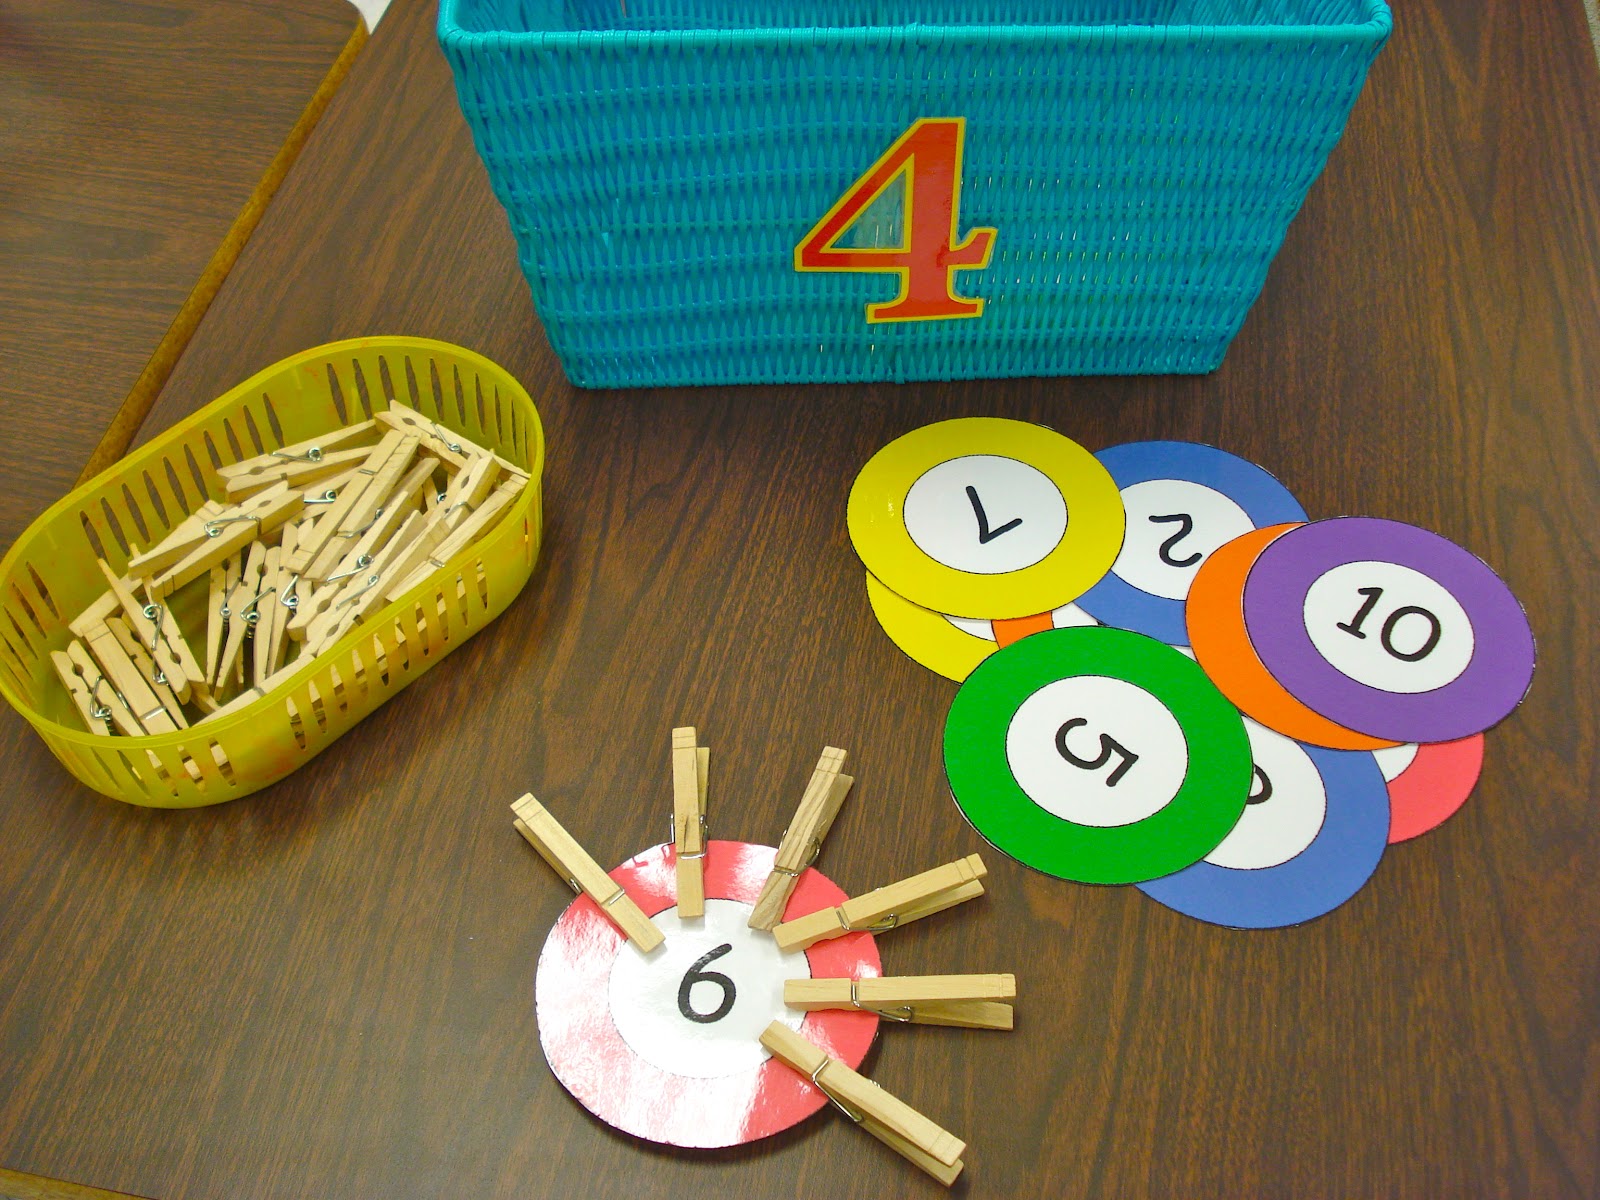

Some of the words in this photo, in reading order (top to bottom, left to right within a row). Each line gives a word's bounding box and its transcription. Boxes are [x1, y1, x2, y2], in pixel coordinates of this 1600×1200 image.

[794, 116, 998, 325] 4
[965, 485, 1023, 545] 7
[1148, 512, 1204, 569] 2
[1336, 586, 1442, 664] 10
[1054, 716, 1140, 788] 5
[677, 943, 737, 1024] 6
